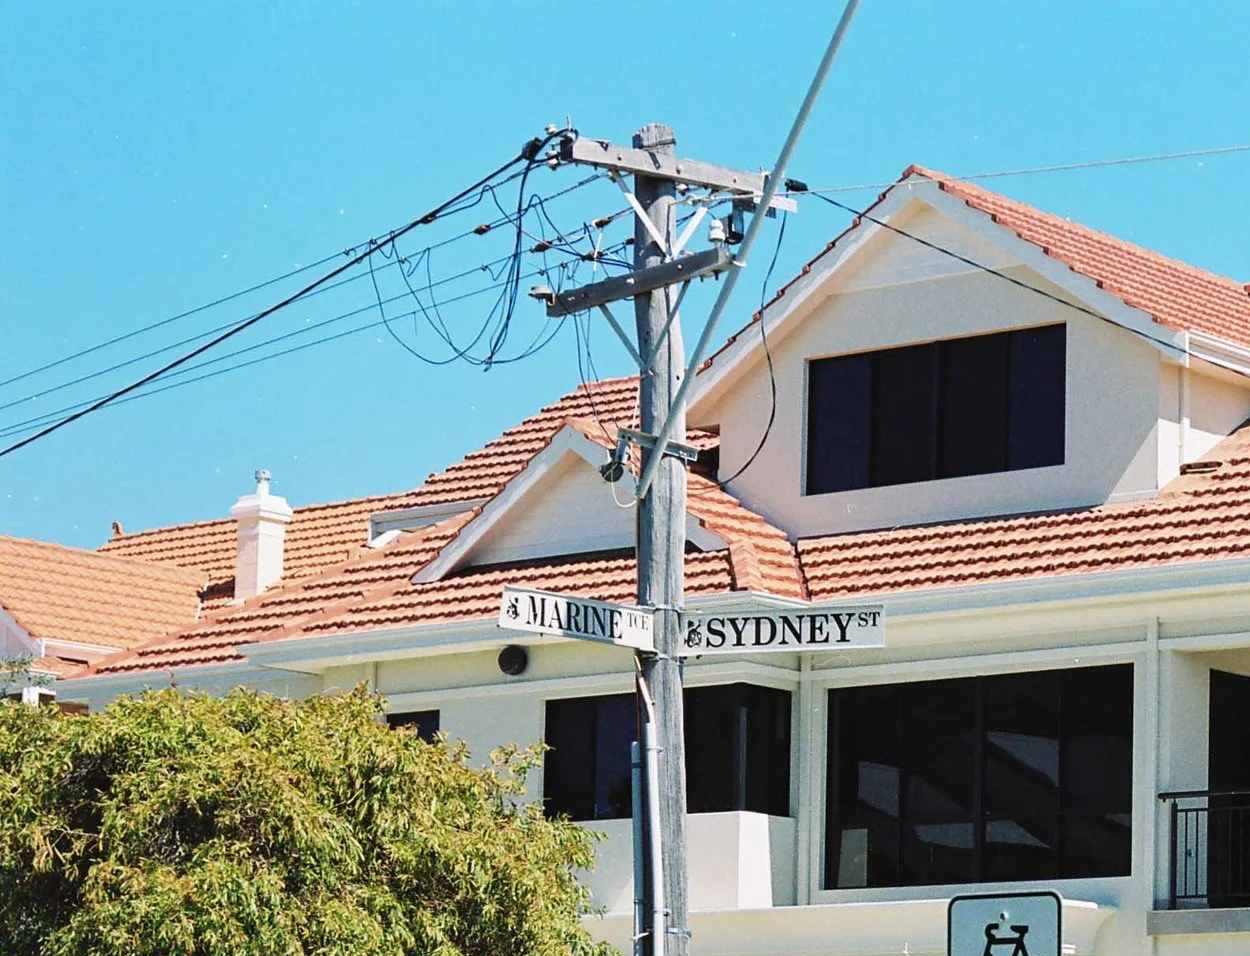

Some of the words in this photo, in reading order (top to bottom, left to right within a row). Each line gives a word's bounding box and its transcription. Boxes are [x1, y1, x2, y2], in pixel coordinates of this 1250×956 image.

[526, 595, 623, 639] MARINE
[626, 612, 649, 631] TCE
[705, 612, 855, 648] SYDNEY
[857, 611, 881, 628] ST
